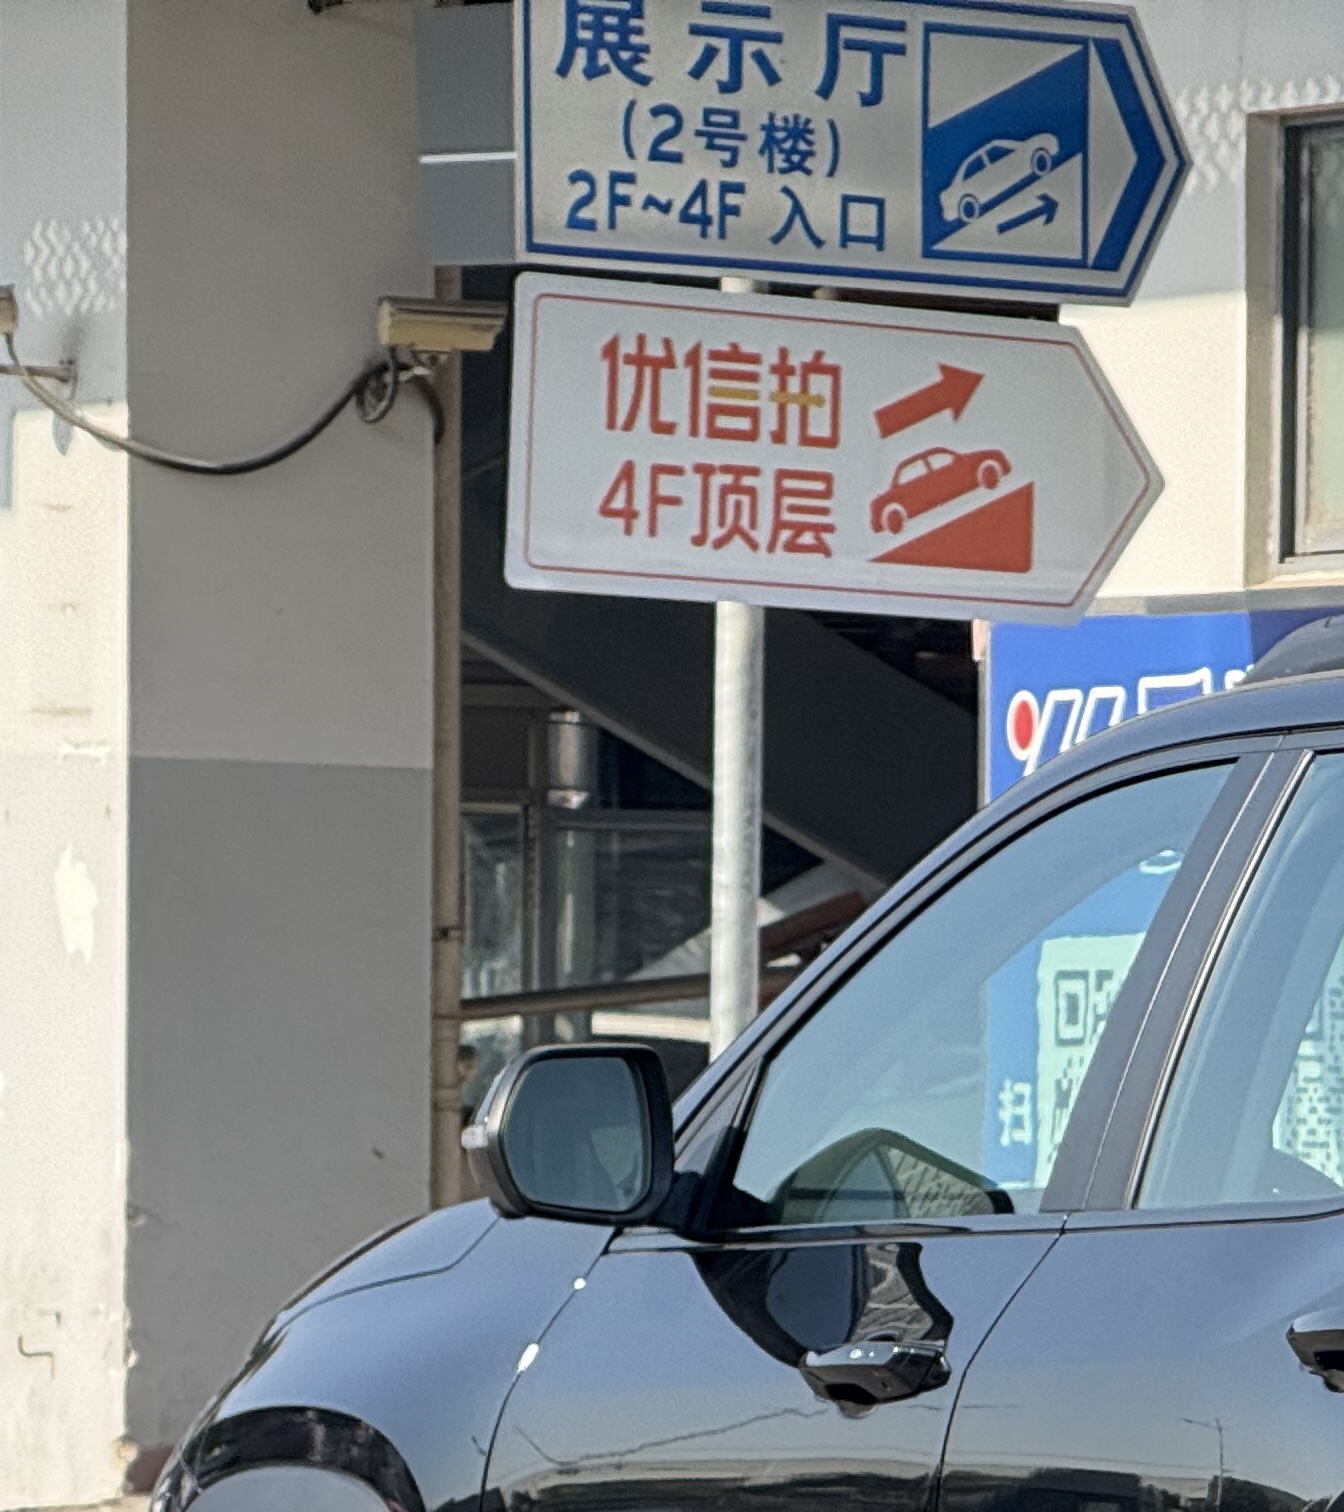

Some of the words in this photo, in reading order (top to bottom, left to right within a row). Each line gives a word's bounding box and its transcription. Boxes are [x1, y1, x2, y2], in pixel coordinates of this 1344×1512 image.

[555, 0, 907, 107] 展示厅
[770, 184, 887, 252] 入口
[599, 332, 842, 449] 优信拍
[597, 459, 836, 557] 4F顶层
